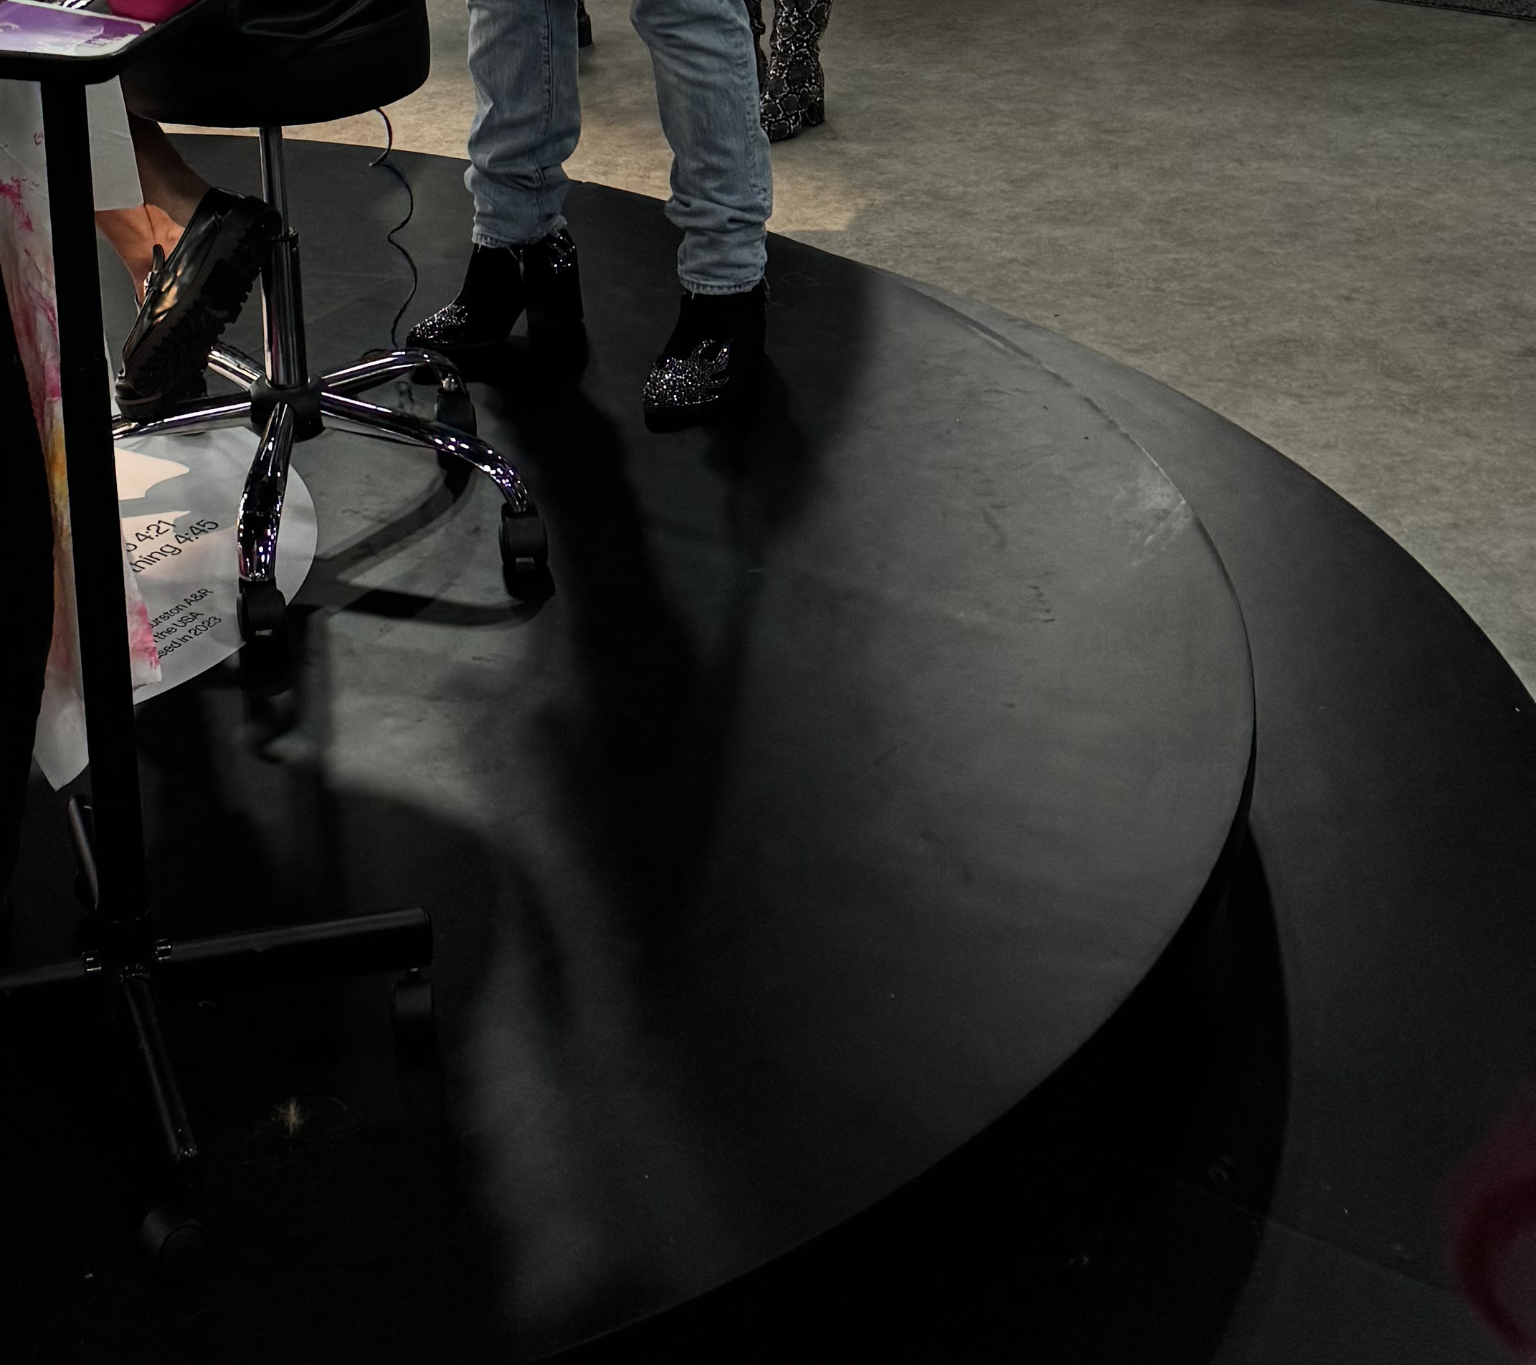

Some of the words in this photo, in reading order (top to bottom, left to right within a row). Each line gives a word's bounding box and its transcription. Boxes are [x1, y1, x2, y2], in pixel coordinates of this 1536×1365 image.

[135, 519, 177, 542] 4:21
[174, 519, 220, 544] 4:45
[183, 587, 213, 607] A&R
[174, 611, 204, 629] USA
[188, 616, 222, 637] 2023
